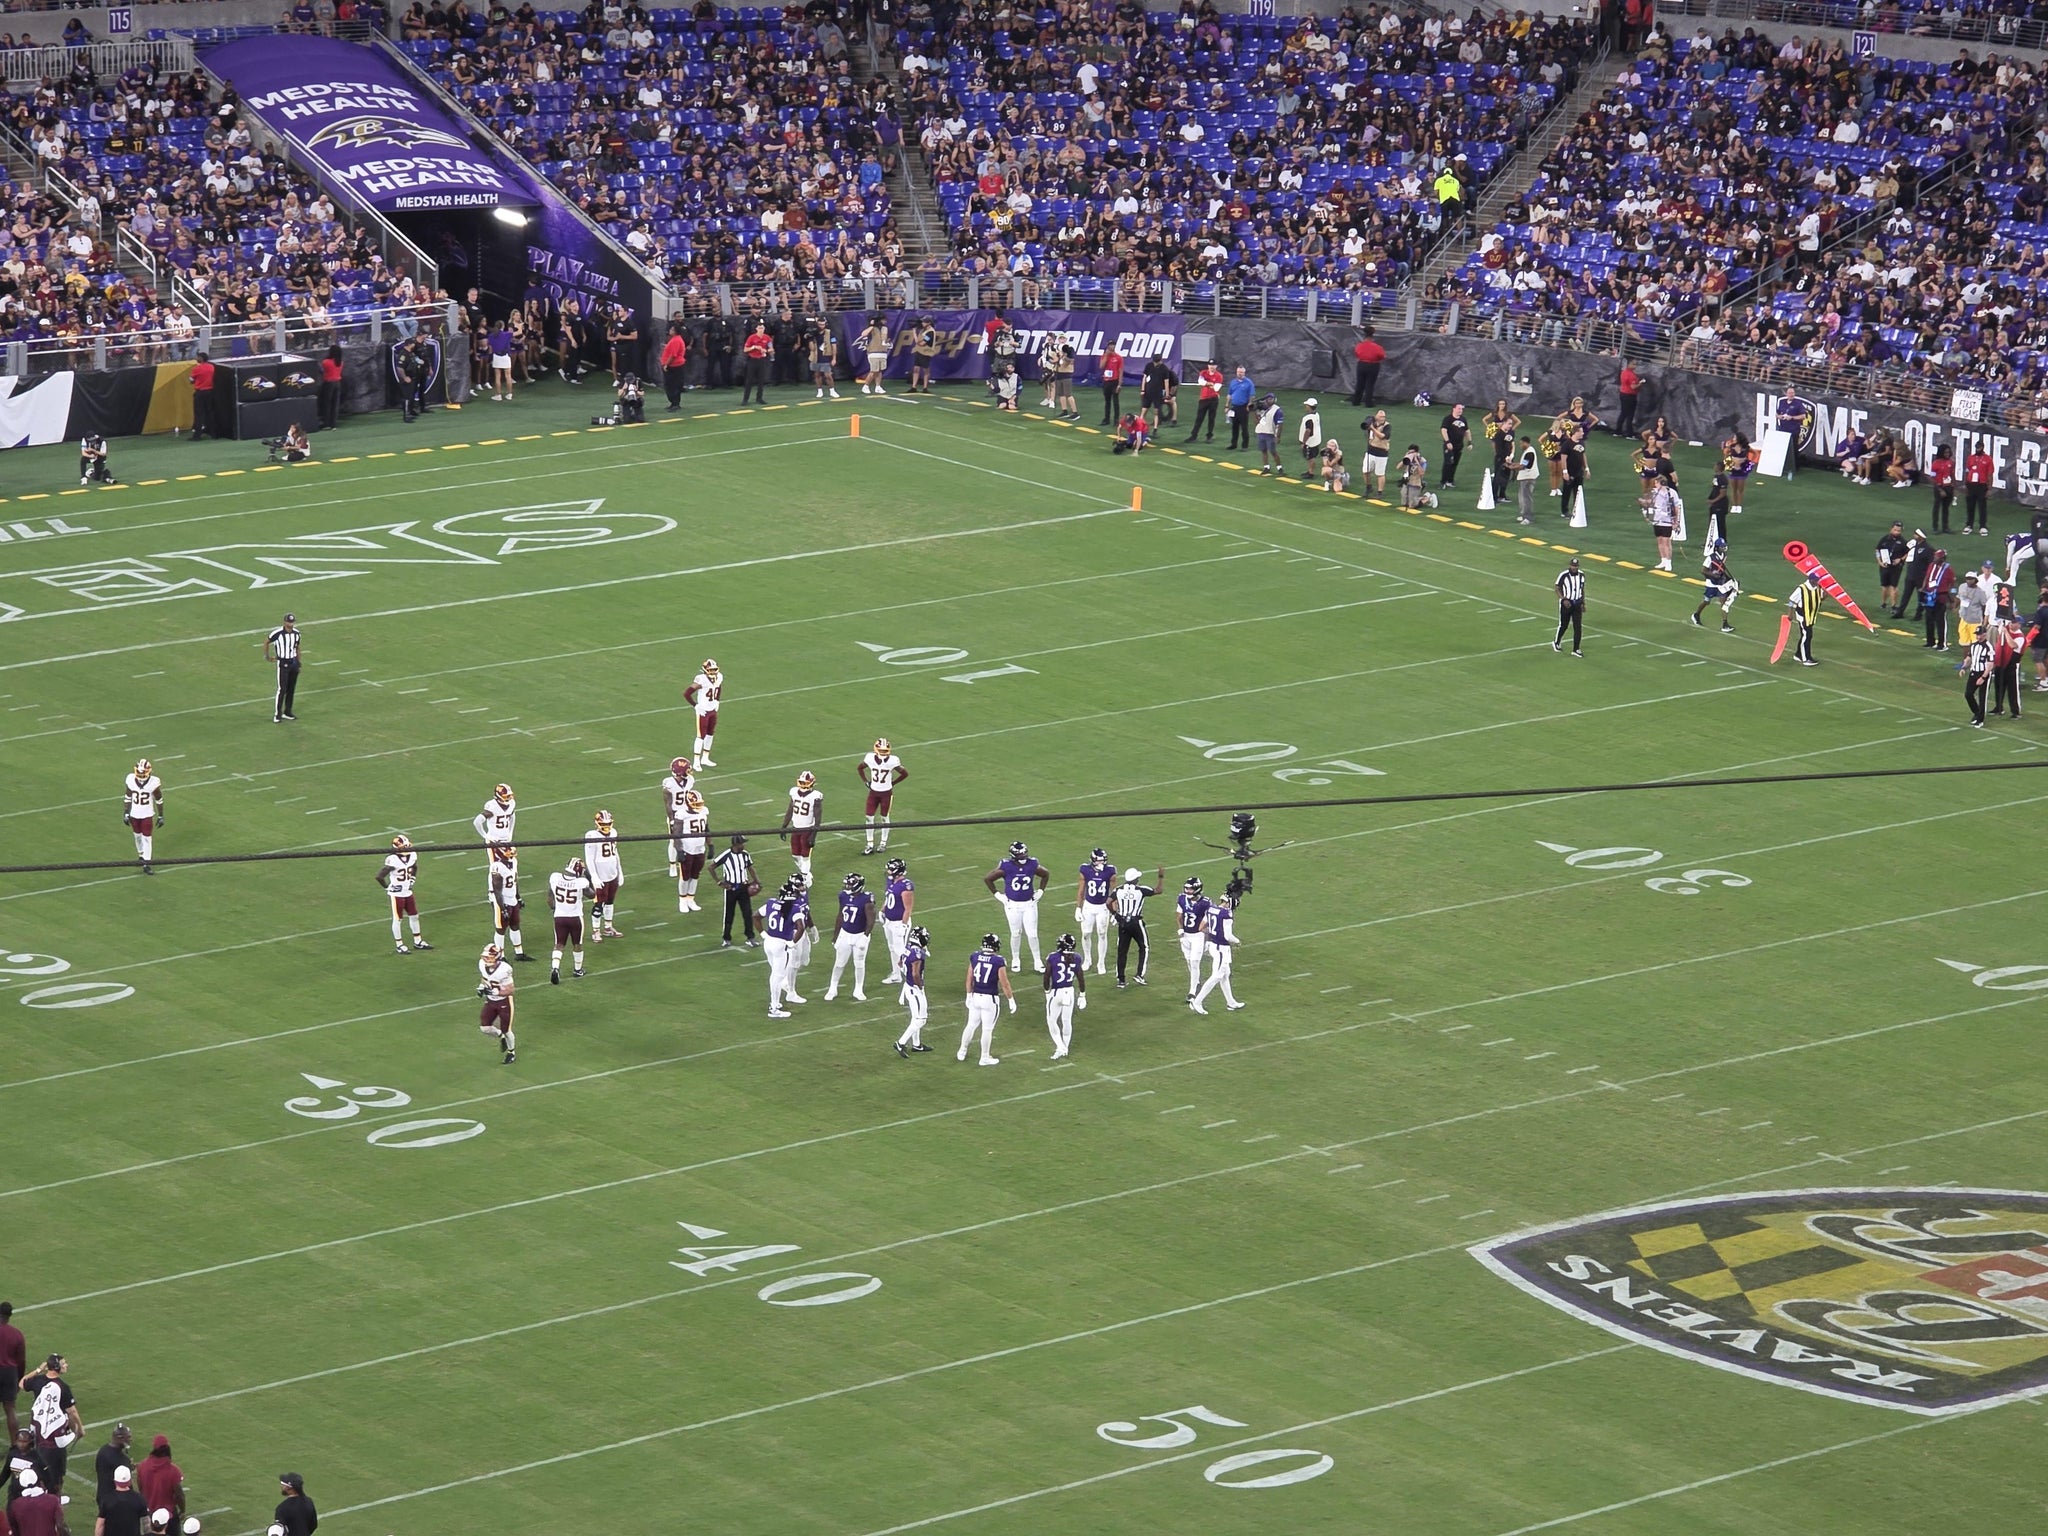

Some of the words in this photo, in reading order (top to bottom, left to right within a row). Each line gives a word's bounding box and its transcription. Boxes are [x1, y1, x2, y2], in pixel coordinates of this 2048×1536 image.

[1253, 0, 1272, 15] 119
[110, 12, 130, 30] 115
[1856, 36, 1875, 54] 121
[1394, 60, 1401, 69] 8
[248, 81, 418, 110] MEDSTAR
[280, 96, 419, 121] HEALTH
[875, 102, 886, 112] 22
[1345, 102, 1358, 112] 22
[1600, 103, 1613, 114] 89
[1053, 122, 1065, 132] 89
[1693, 146, 1700, 157] 8
[331, 156, 503, 184] MEDSTAR
[1140, 157, 1146, 168] 8
[362, 170, 504, 194] HEALTH
[1726, 186, 1733, 197] 8
[396, 195, 452, 208] MEDSTAR
[454, 193, 499, 206] HEALTH
[874, 201, 882, 212] 5
[997, 216, 1009, 226] 90
[205, 231, 214, 241] 18
[1984, 253, 1995, 265] 12
[526, 245, 584, 287] PLAY
[584, 270, 610, 292] LIKE
[609, 280, 620, 297] A
[1151, 281, 1161, 292] 91
[1796, 279, 1804, 290] 8
[133, 310, 140, 320] 8
[1905, 419, 1941, 475] OF
[0, 499, 677, 622] ENS
[706, 688, 720, 702] 40
[872, 768, 890, 784] 37
[131, 791, 150, 805] 32
[792, 800, 810, 816] 59
[1011, 876, 1032, 891] 62
[1087, 880, 1107, 897] 84
[556, 885, 578, 905] 55
[1123, 891, 1135, 900] 20
[769, 911, 784, 932] 61
[842, 906, 859, 924] 67
[1183, 912, 1198, 928] 13
[973, 963, 993, 984] 47
[1056, 962, 1077, 984] 35
[284, 1086, 486, 1149] 30
[668, 1244, 882, 1307] 40
[1546, 1254, 1934, 1392] RAVENS
[1096, 1406, 1334, 1489] 50
